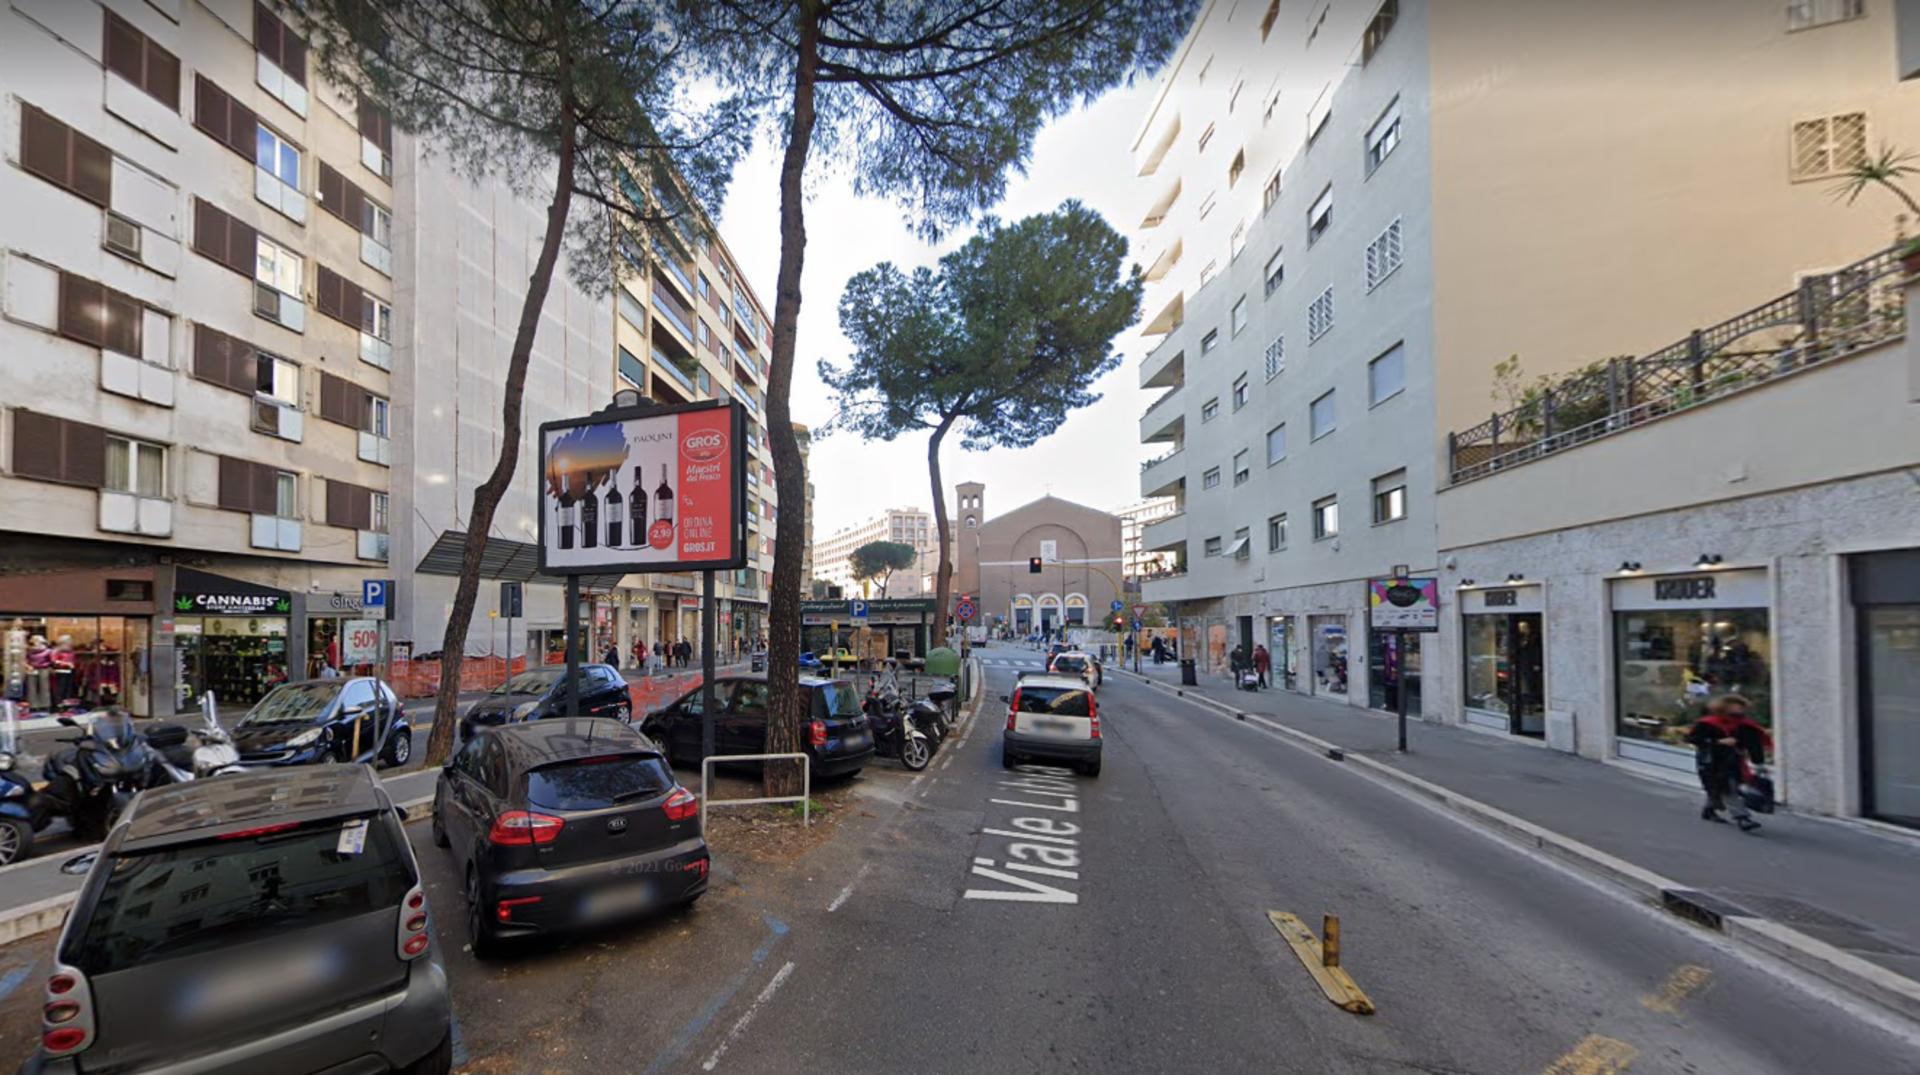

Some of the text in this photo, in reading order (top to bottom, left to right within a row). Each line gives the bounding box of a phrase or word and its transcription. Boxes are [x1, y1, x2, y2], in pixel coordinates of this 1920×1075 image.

[686, 434, 720, 448] GROS
[683, 542, 716, 553] GROS.IT
[367, 583, 381, 604] P
[853, 601, 865, 617] P
